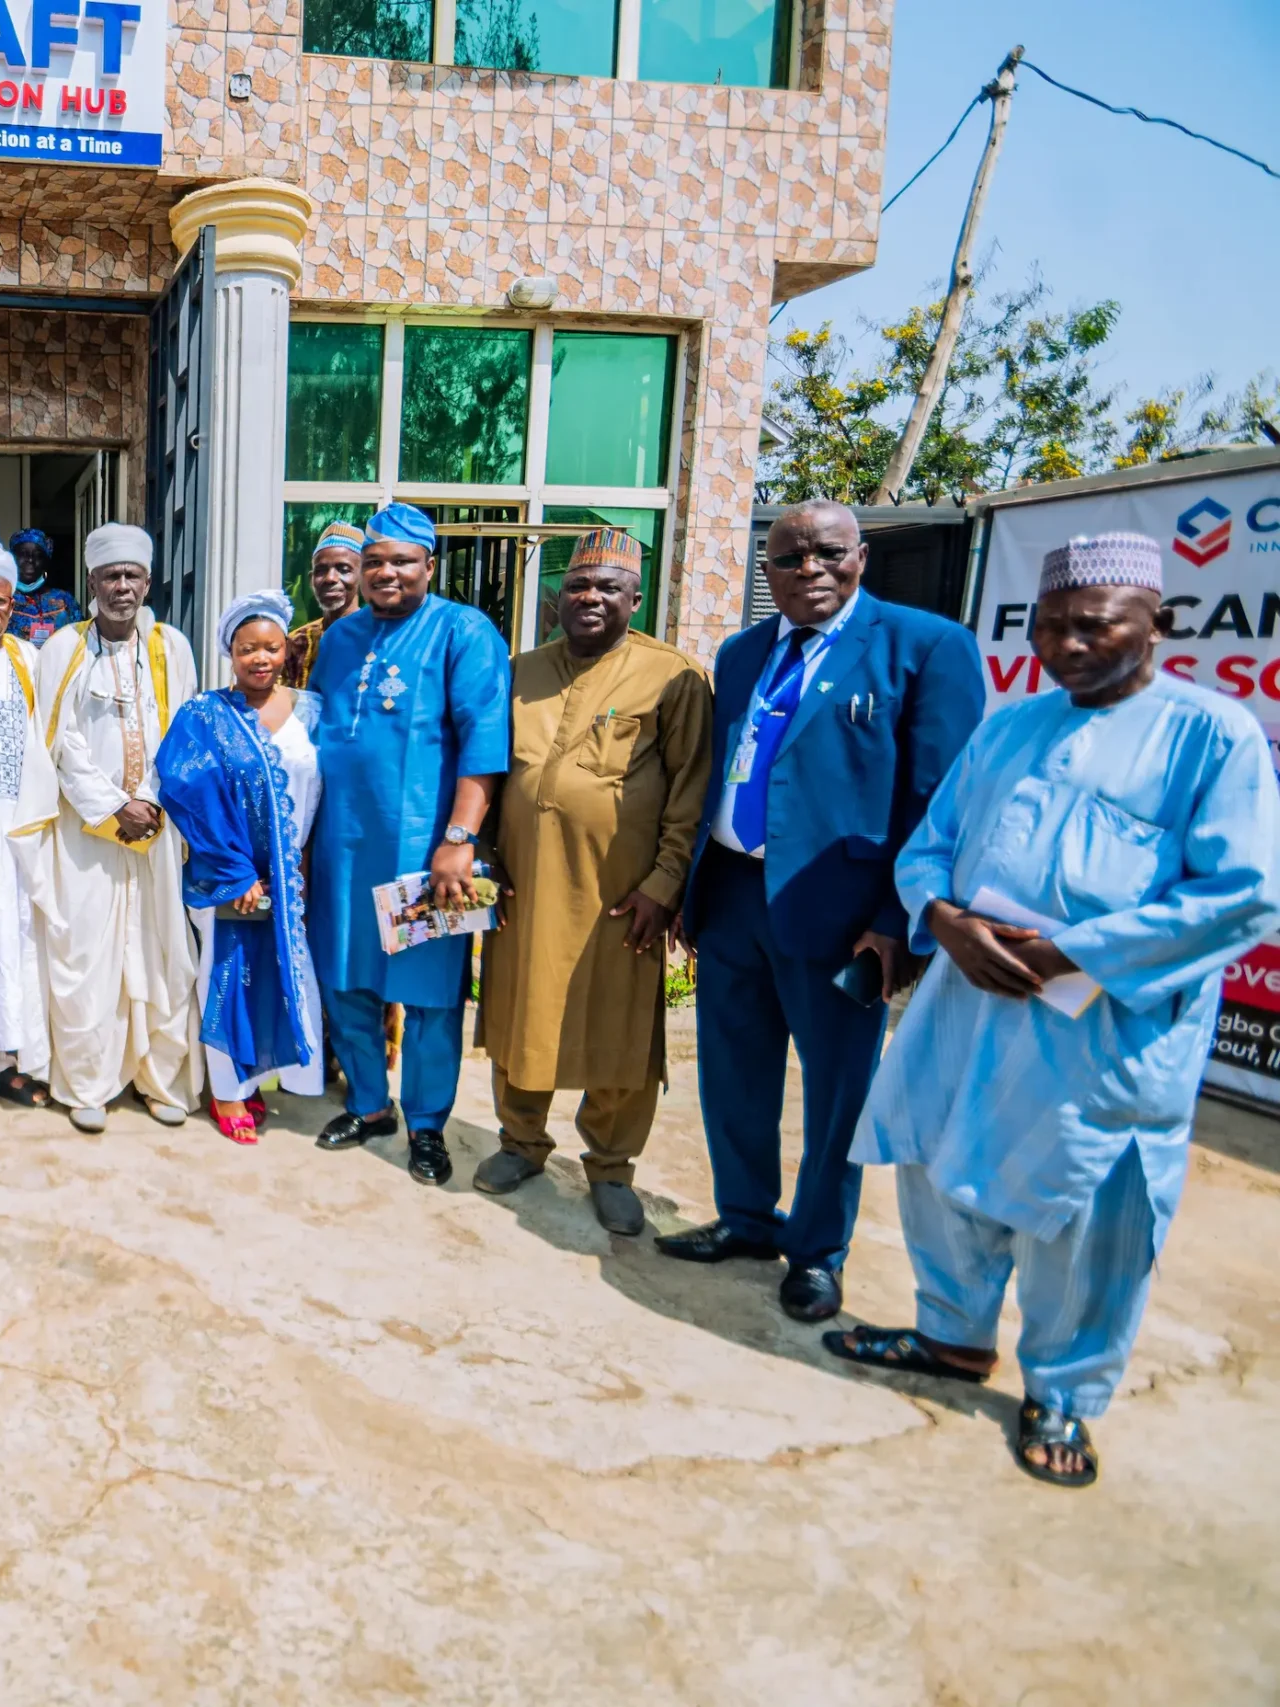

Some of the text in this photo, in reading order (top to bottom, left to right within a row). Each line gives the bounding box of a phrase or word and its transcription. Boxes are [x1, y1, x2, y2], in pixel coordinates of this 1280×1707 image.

[61, 84, 128, 116] HUB
[36, 134, 56, 150] at
[60, 137, 72, 152] a
[77, 136, 123, 155] Time
